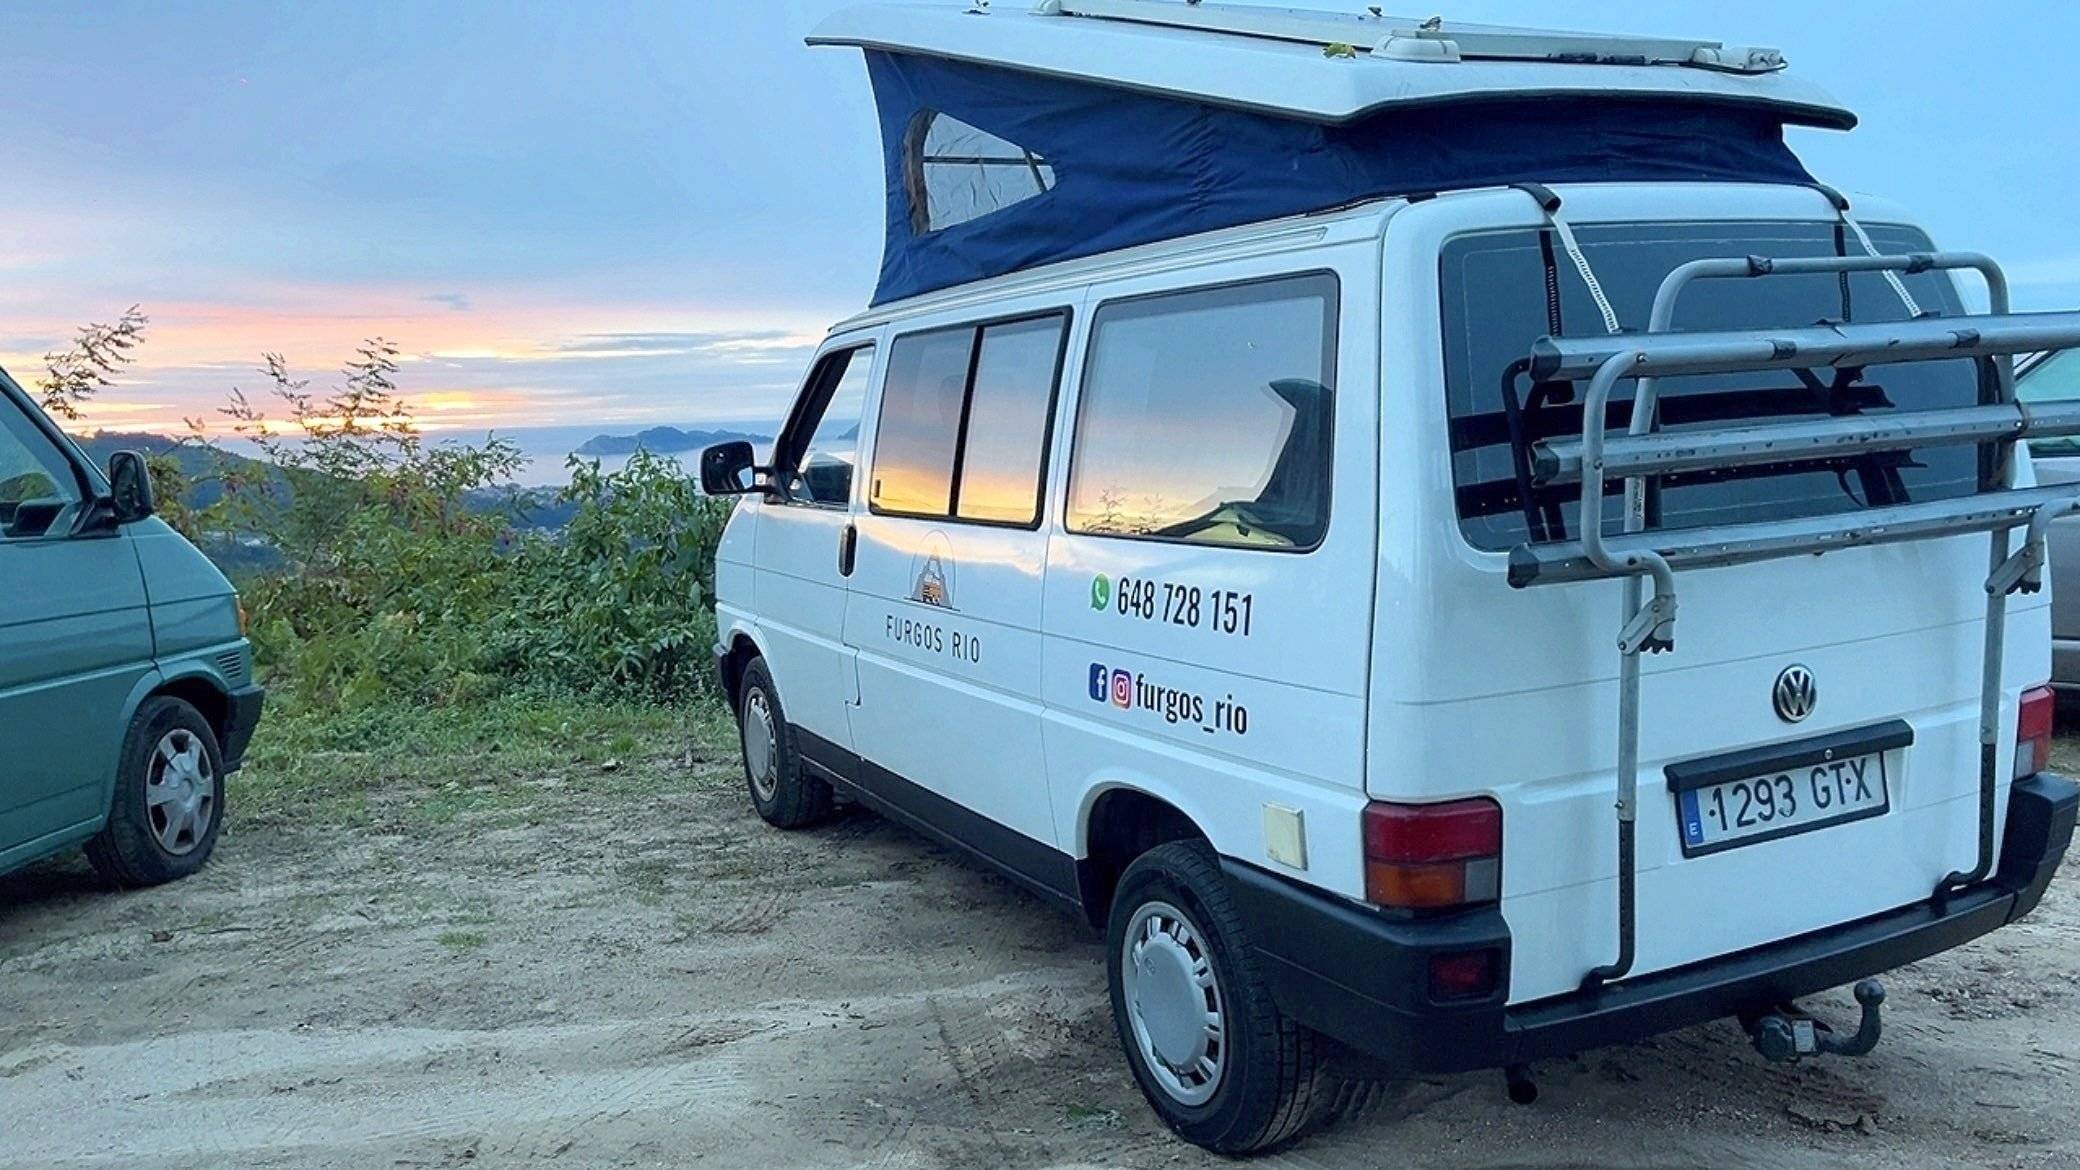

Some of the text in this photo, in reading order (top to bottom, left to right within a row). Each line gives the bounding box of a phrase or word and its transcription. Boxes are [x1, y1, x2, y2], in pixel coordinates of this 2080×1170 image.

[1117, 577, 1253, 636] 648 728 151
[886, 615, 981, 664] FURGOS RIO
[1136, 673, 1248, 735] furgos_rio
[1713, 758, 1872, 831] 1293 GTX
[1688, 822, 1698, 836] E
